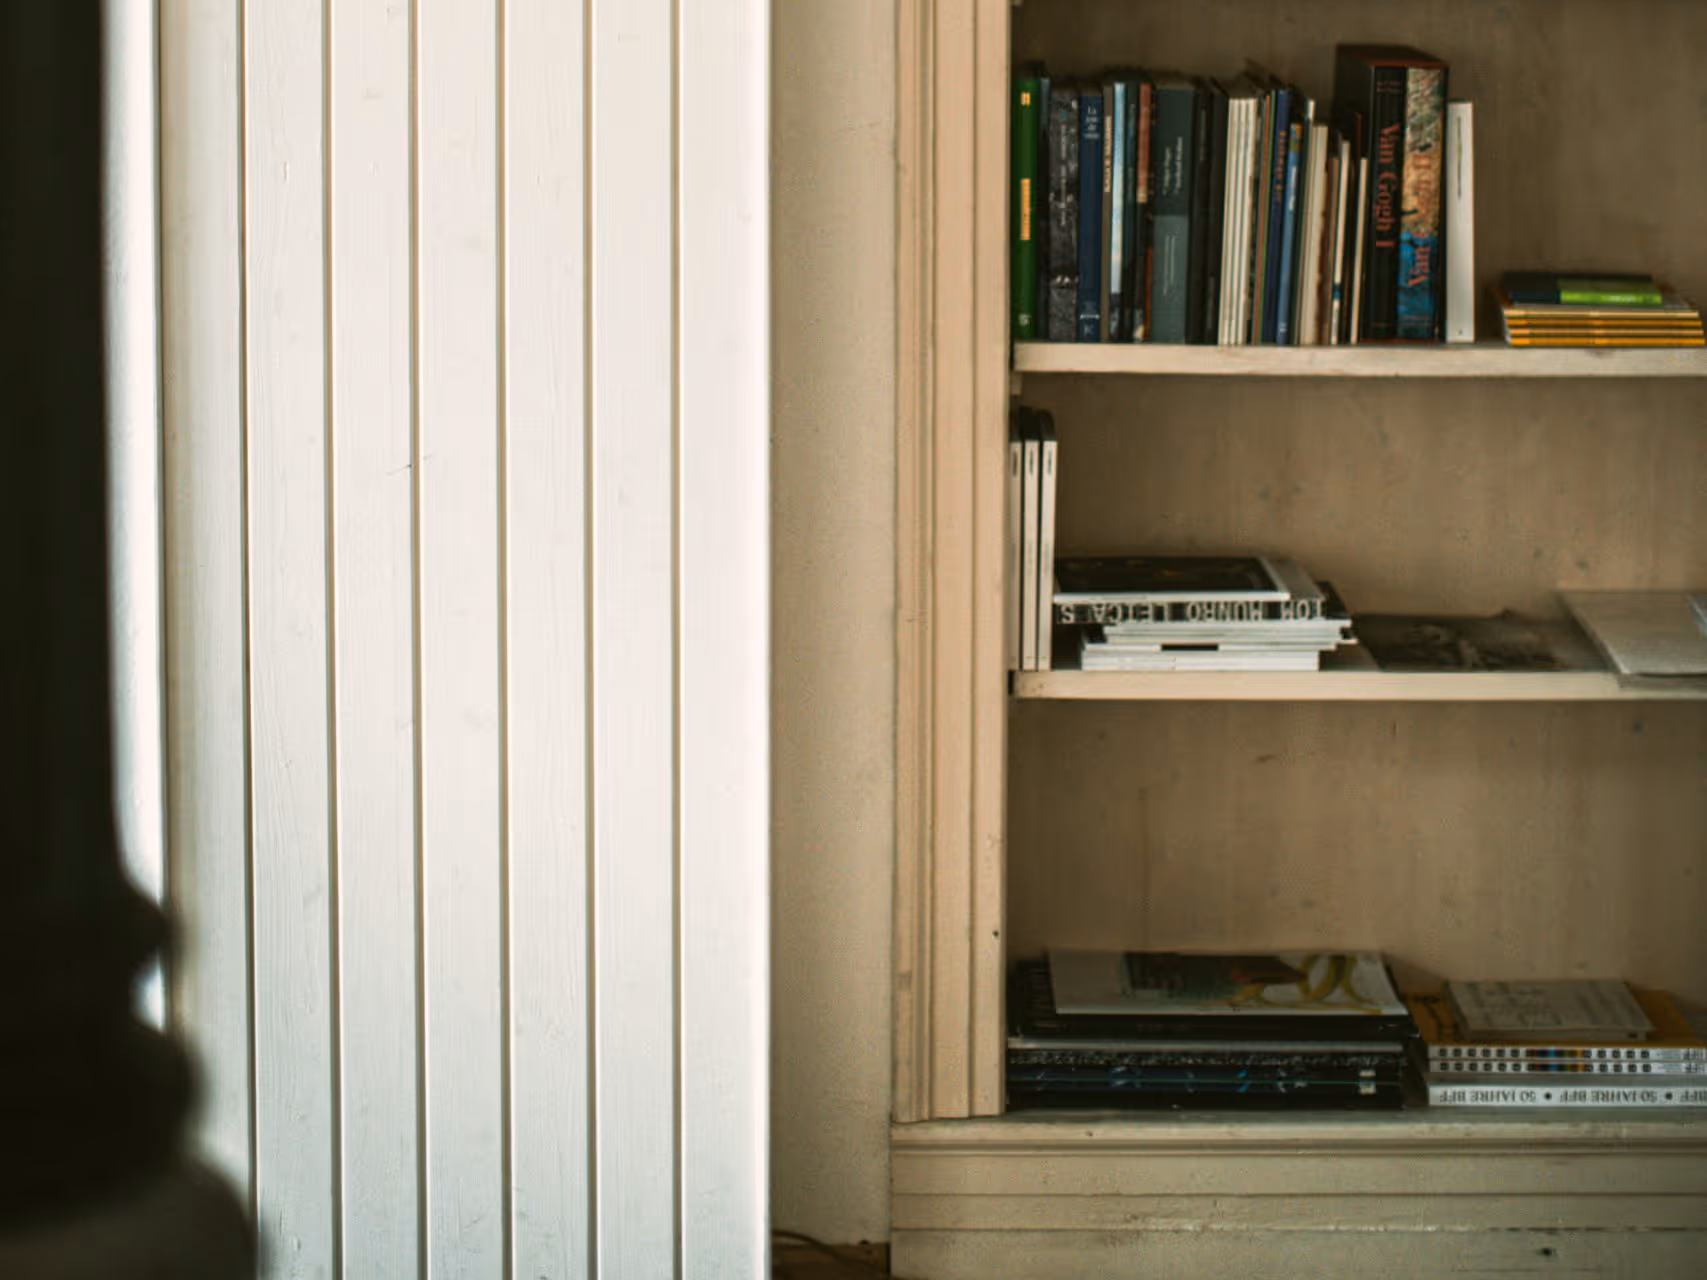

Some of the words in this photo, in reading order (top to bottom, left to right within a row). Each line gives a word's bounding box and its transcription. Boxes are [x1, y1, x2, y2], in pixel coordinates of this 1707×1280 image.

[1378, 123, 1401, 164] Van
[1376, 171, 1398, 231] Gogh
[1375, 240, 1396, 249] I
[1407, 246, 1430, 287] Van
[1059, 603, 1075, 623] S
[1092, 602, 1169, 623] LEICA
[1185, 601, 1263, 622] MUNRO
[1280, 598, 1325, 620] TOM
[1439, 1090, 1465, 1103] BFF
[1639, 1090, 1658, 1102] 50
